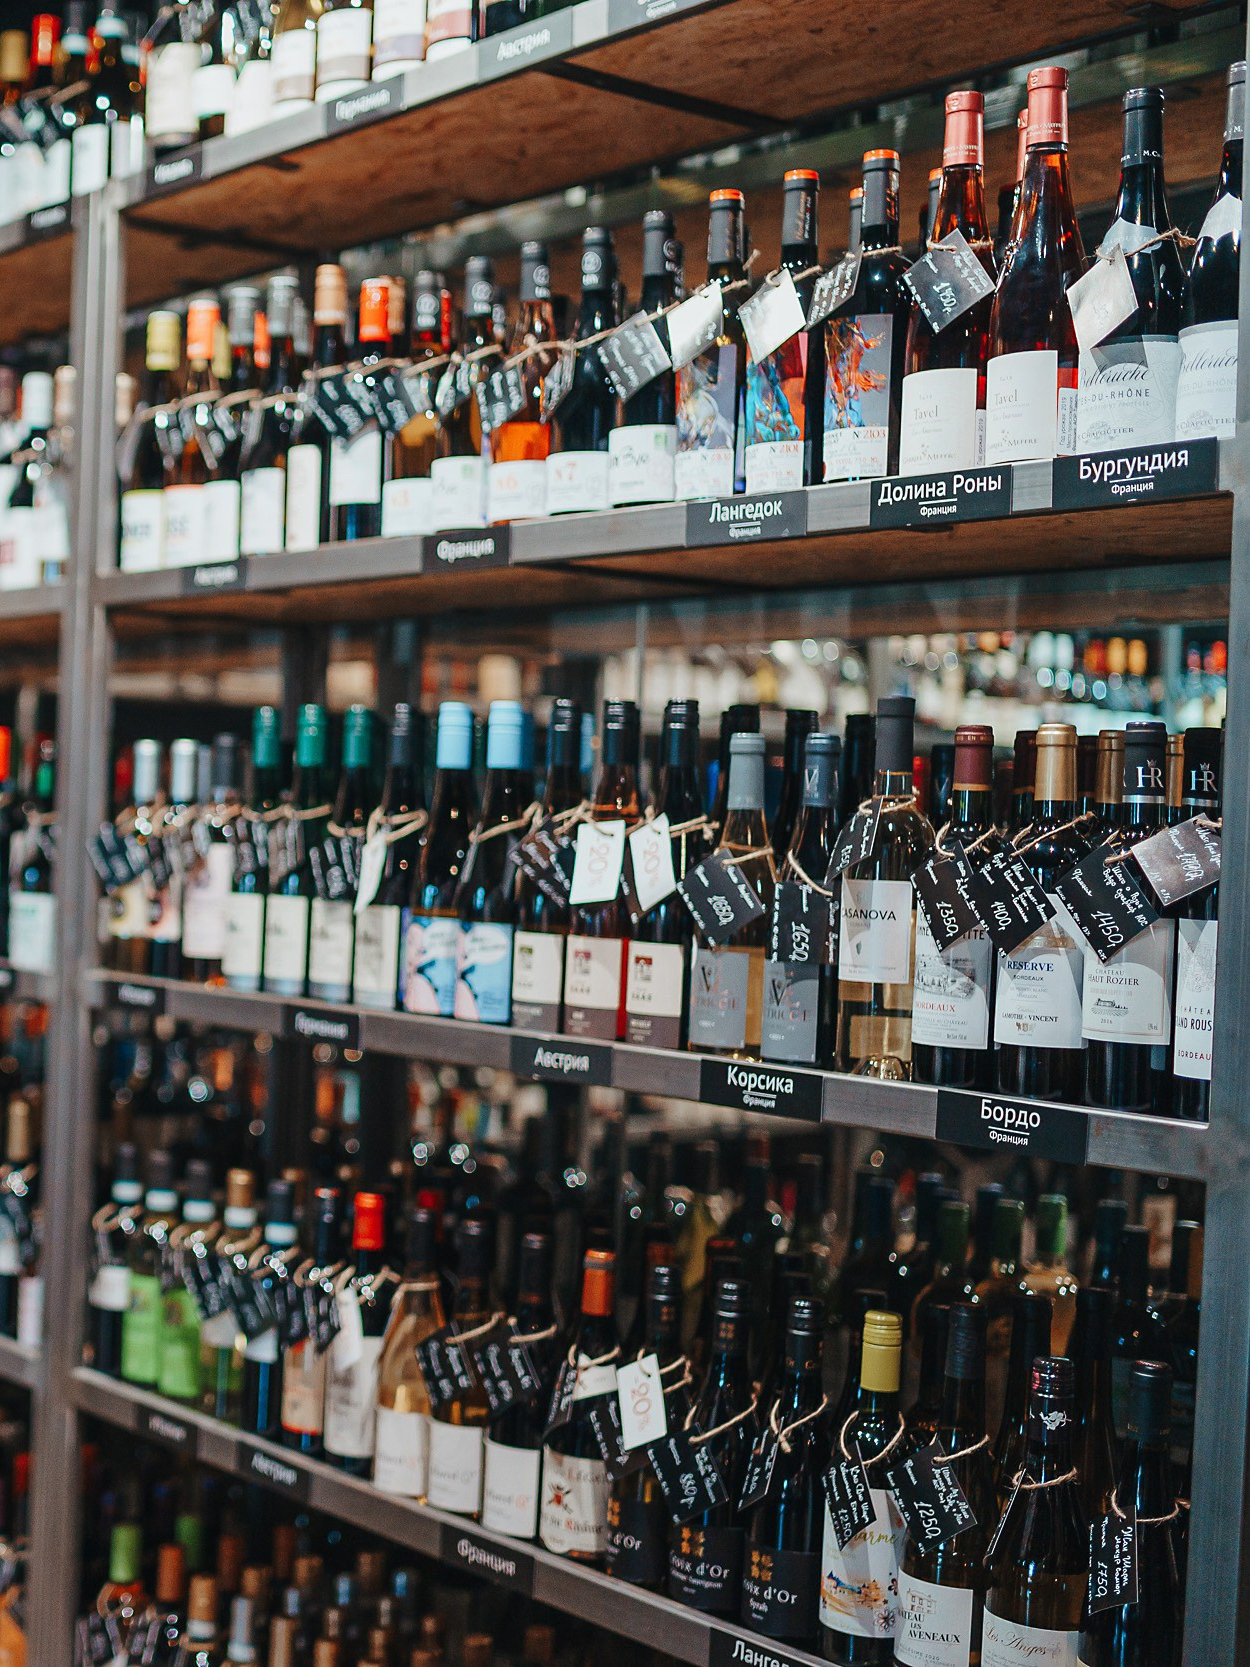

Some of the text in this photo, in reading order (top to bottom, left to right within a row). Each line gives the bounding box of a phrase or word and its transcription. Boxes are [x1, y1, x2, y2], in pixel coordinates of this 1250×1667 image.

[994, 389, 1018, 406] Tavel
[914, 405, 938, 421] Tavel
[1079, 447, 1190, 481] Бургундия
[877, 471, 1002, 505] Долина Роны
[1110, 480, 1155, 495] Франция
[708, 499, 783, 524] Лангедок
[919, 503, 958, 516] Франция
[437, 537, 495, 563] Франция
[1071, 868, 1092, 896] Франция
[842, 908, 897, 921] CASANOVA
[1007, 960, 1054, 972] RESERVE
[1106, 975, 1139, 986] ROZIER
[1028, 1014, 1059, 1023] VINCENT
[534, 1046, 590, 1073] Австрия
[726, 1065, 794, 1094] Корсика
[742, 1094, 776, 1109] Франция
[980, 1098, 1041, 1129] Бордо
[988, 1129, 1029, 1147] Франция
[456, 1538, 516, 1577] Франция
[1121, 1526, 1133, 1586] Жан Шарль
[696, 1563, 730, 1579] d'Or
[764, 1586, 798, 1605] d'Or
[910, 1621, 922, 1630] LES
[908, 1629, 961, 1644] AVENEAUX
